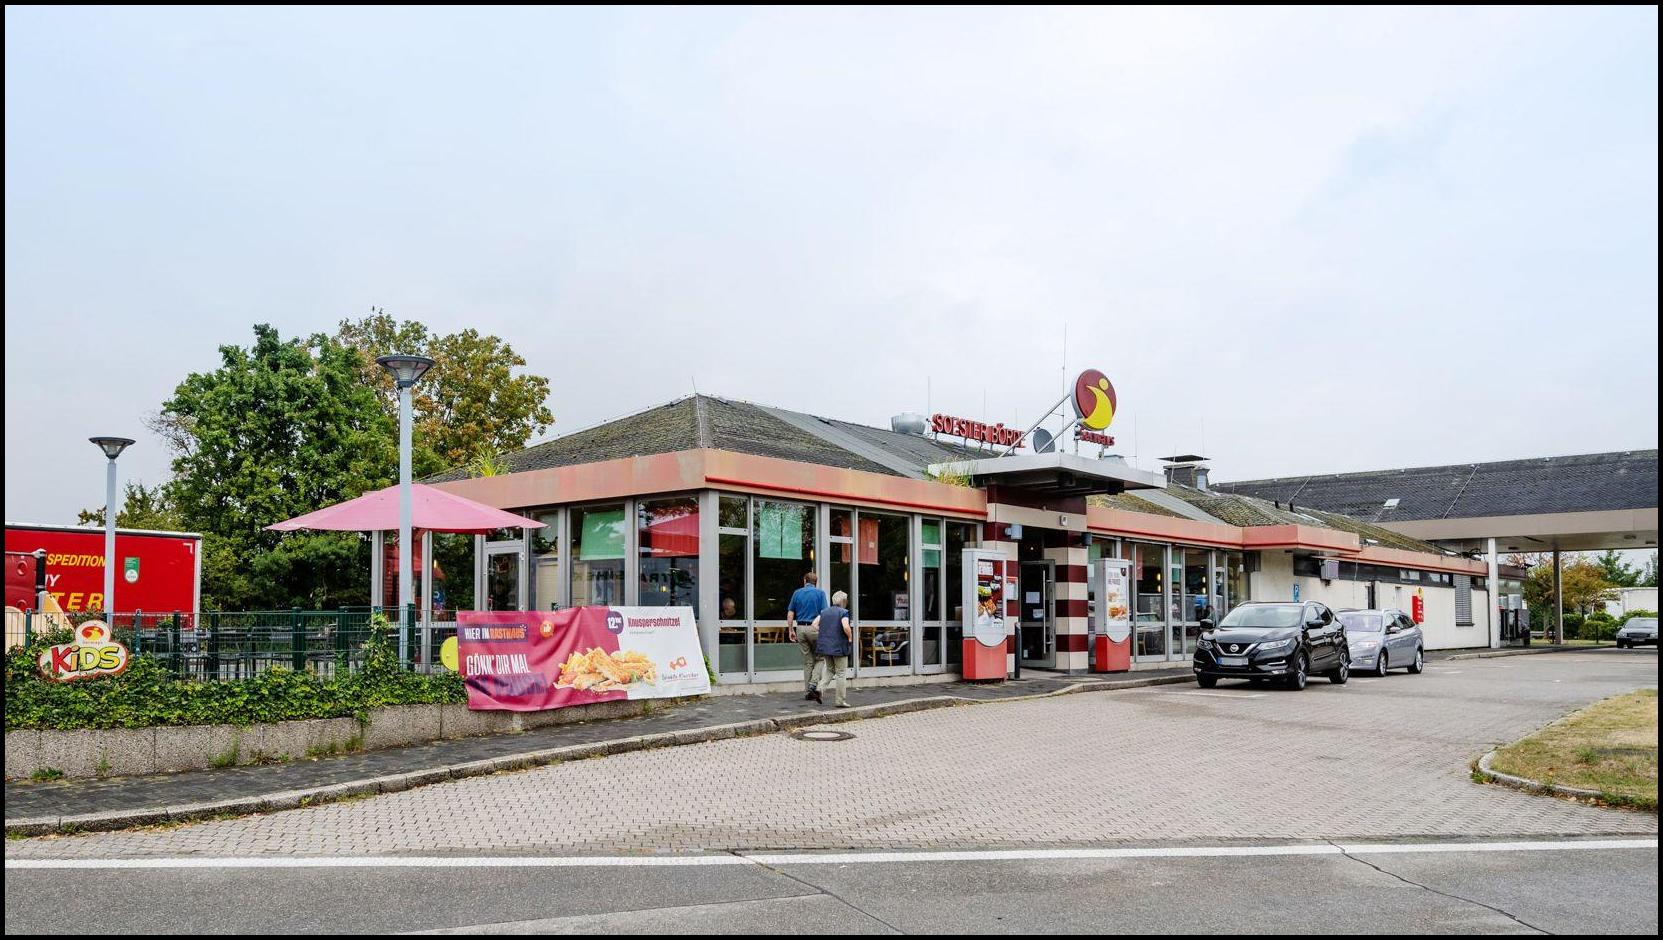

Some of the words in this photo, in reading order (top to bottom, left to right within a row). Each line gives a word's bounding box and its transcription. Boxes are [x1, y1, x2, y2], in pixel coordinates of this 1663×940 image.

[932, 414, 987, 443] SOESTER
[46, 554, 106, 567] SPEDITION
[628, 616, 681, 629] Knusperschnitzel
[464, 627, 481, 640] HIER
[490, 627, 526, 640] RASTHAUS
[495, 654, 511, 675] DIR
[511, 653, 531, 674] MAL
